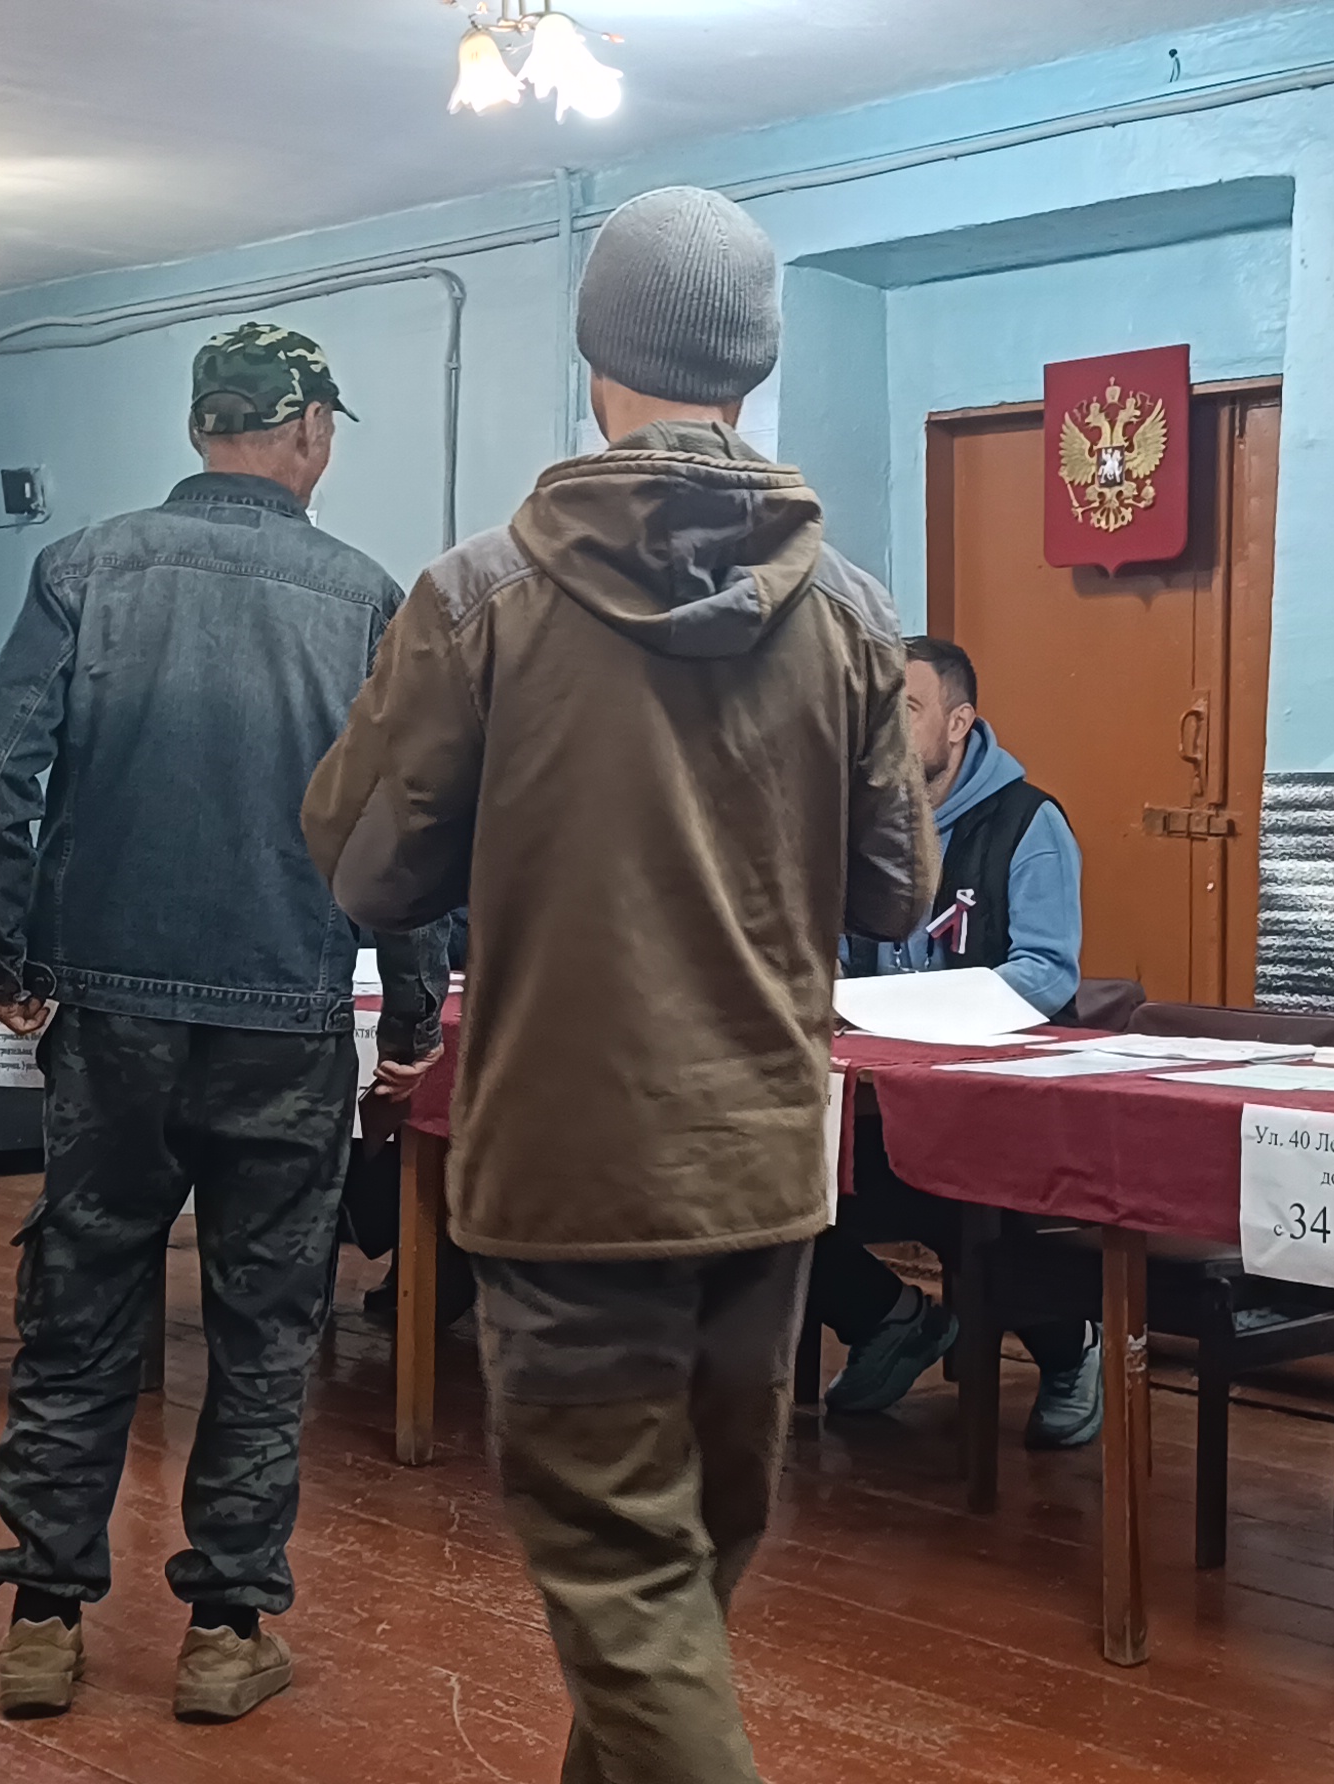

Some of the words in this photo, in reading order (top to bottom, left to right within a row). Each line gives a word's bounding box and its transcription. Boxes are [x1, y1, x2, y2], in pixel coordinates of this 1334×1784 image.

[355, 1025, 377, 1039] ктяб
[1255, 1125, 1284, 1147] Ул.
[1289, 1130, 1310, 1149] 40
[1273, 1223, 1283, 1236] с
[1289, 1202, 1331, 1243] 34
